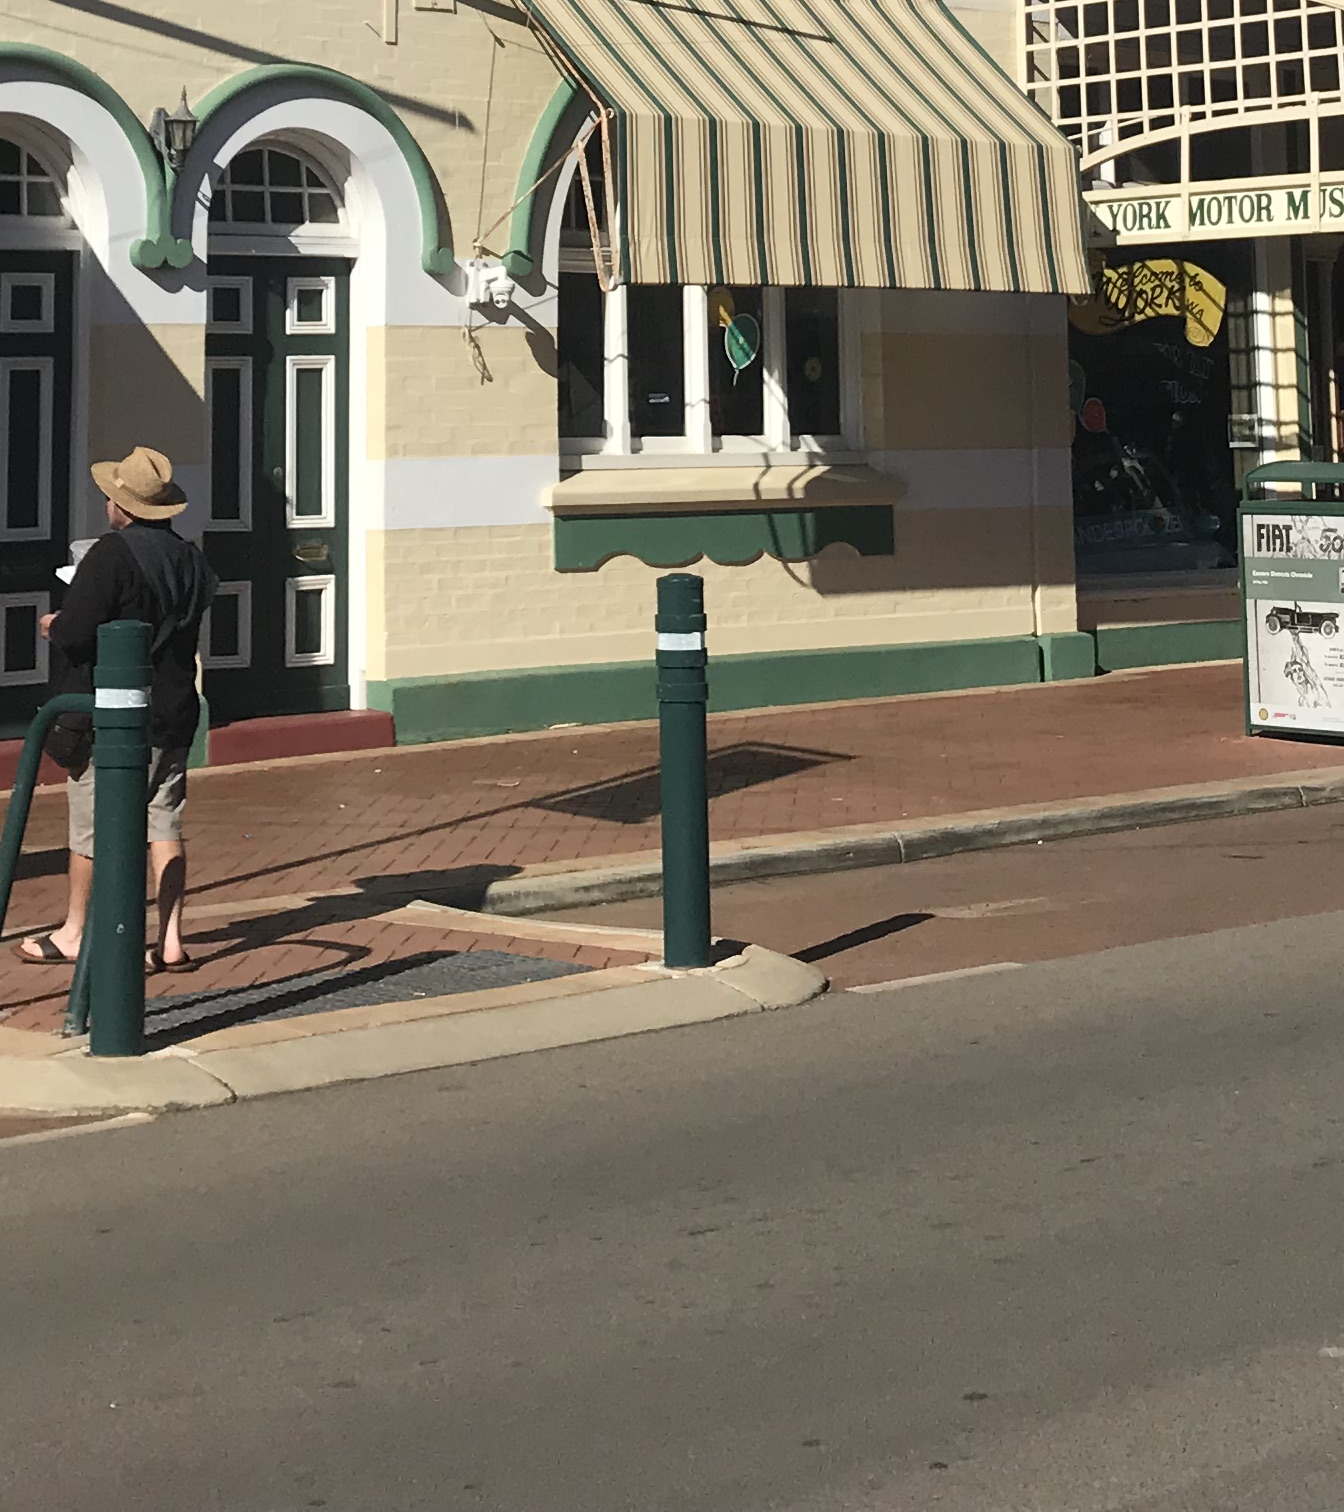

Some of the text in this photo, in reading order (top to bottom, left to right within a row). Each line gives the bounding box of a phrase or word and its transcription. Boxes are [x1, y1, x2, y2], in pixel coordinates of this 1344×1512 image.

[1107, 199, 1172, 233] YORK
[1188, 192, 1274, 227] MOTOR
[1095, 263, 1204, 305] Welcome to
[1099, 284, 1186, 326] YORK
[1186, 298, 1205, 321] WA
[1256, 523, 1293, 554] FIAT
